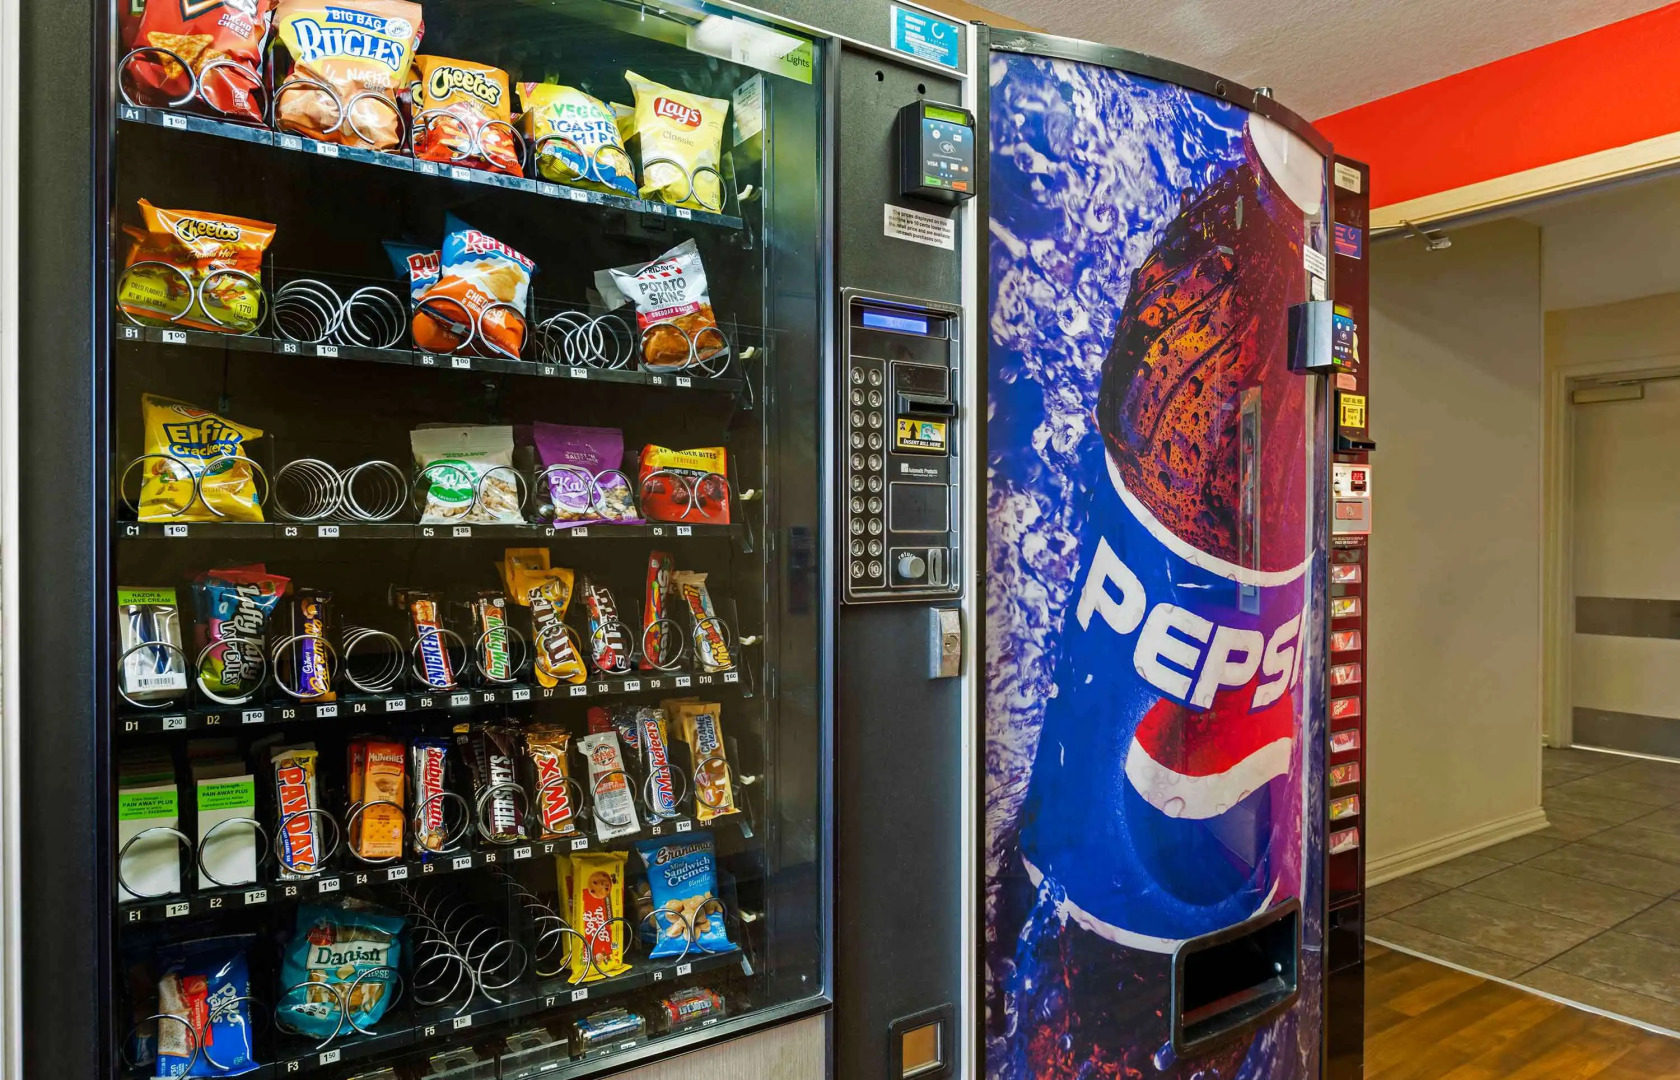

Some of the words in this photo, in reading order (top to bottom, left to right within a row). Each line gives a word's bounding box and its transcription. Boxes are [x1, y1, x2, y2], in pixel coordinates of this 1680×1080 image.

[222, 13, 252, 32] NACHO
[332, 10, 354, 22] BIG
[356, 14, 382, 29] BAG
[218, 20, 250, 39] CHEESE
[291, 18, 404, 71] BUGLES
[786, 51, 810, 68] Lights
[346, 68, 390, 87] NACHO
[430, 66, 502, 107] Cheetos
[125, 108, 139, 120] A1
[658, 98, 700, 124] Lay's
[662, 131, 694, 147] Classic
[914, 214, 934, 223] displayed
[176, 218, 241, 242] Cheetos
[638, 277, 687, 295] POTATO
[648, 290, 686, 306] SKINS
[238, 304, 252, 314] 170
[651, 308, 674, 318] CHEDDAR
[125, 328, 138, 338] B1
[284, 343, 298, 354] B3
[422, 355, 434, 364] B5
[544, 367, 554, 375] B7
[167, 419, 240, 444] Elfin
[172, 443, 234, 456] Crackers
[698, 450, 717, 460] BITES
[126, 526, 140, 536] C1
[284, 526, 298, 536] C3
[424, 528, 434, 536] C5
[545, 528, 555, 536] C7
[234, 583, 264, 634] Laffy
[1076, 535, 1307, 709] PEPSI
[418, 624, 447, 686] SNICKERS
[598, 684, 608, 692] D8
[650, 680, 660, 688] D9
[484, 694, 495, 702] D6
[544, 689, 554, 698] D7
[354, 704, 366, 712] D4
[420, 698, 432, 707] D5
[282, 709, 296, 718] D3
[126, 720, 139, 732] D1
[206, 715, 220, 726] D2
[368, 752, 404, 764] MUNCHIES
[645, 720, 673, 794] Musketeers
[424, 748, 443, 788] Baby
[490, 754, 516, 828] HERSHEY'S
[539, 756, 572, 831] TWIX
[278, 766, 316, 865] PAYDAY
[652, 826, 662, 834] E9
[544, 844, 554, 853] E7
[486, 854, 496, 862] E6
[423, 864, 434, 872] E5
[664, 856, 710, 879] Sandwich
[670, 861, 684, 870] Mini
[356, 875, 368, 884] E4
[668, 865, 710, 886] Cremes
[688, 874, 711, 887] Vanilla
[285, 886, 297, 896] E3
[210, 898, 222, 908] E2
[129, 911, 141, 920] E1
[582, 910, 594, 936] Soft
[314, 946, 381, 966] Danish
[356, 969, 390, 980] CHEESE
[654, 972, 662, 980] F9
[546, 997, 556, 1006] F7
[424, 1026, 436, 1037] F5
[288, 1061, 299, 1072] F3
